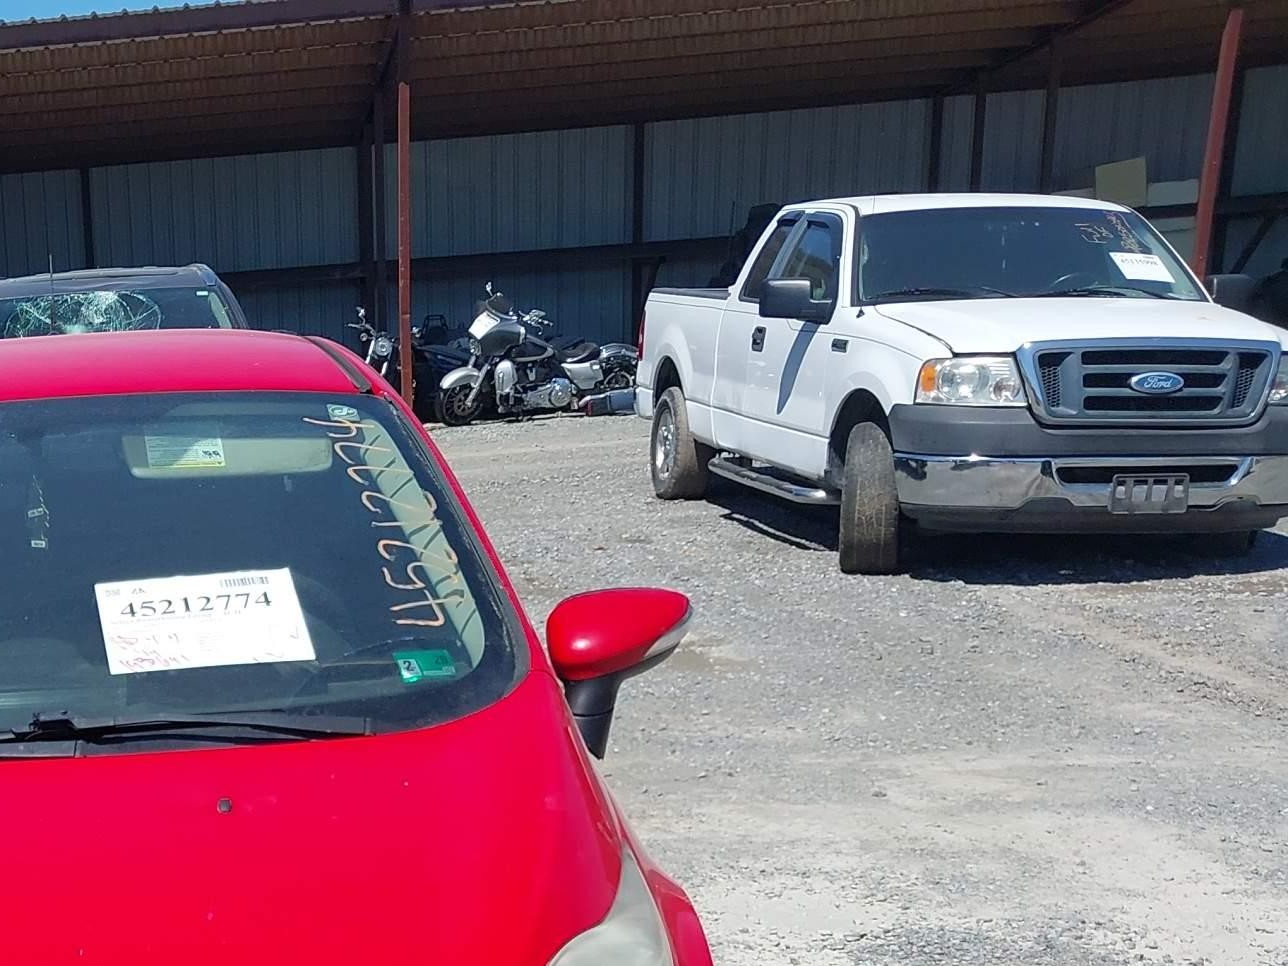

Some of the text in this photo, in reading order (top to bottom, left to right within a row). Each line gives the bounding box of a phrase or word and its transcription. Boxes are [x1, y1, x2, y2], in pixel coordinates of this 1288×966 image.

[1143, 375, 1174, 389] Ford
[120, 591, 273, 617] 45212774
[402, 660, 415, 672] 2
